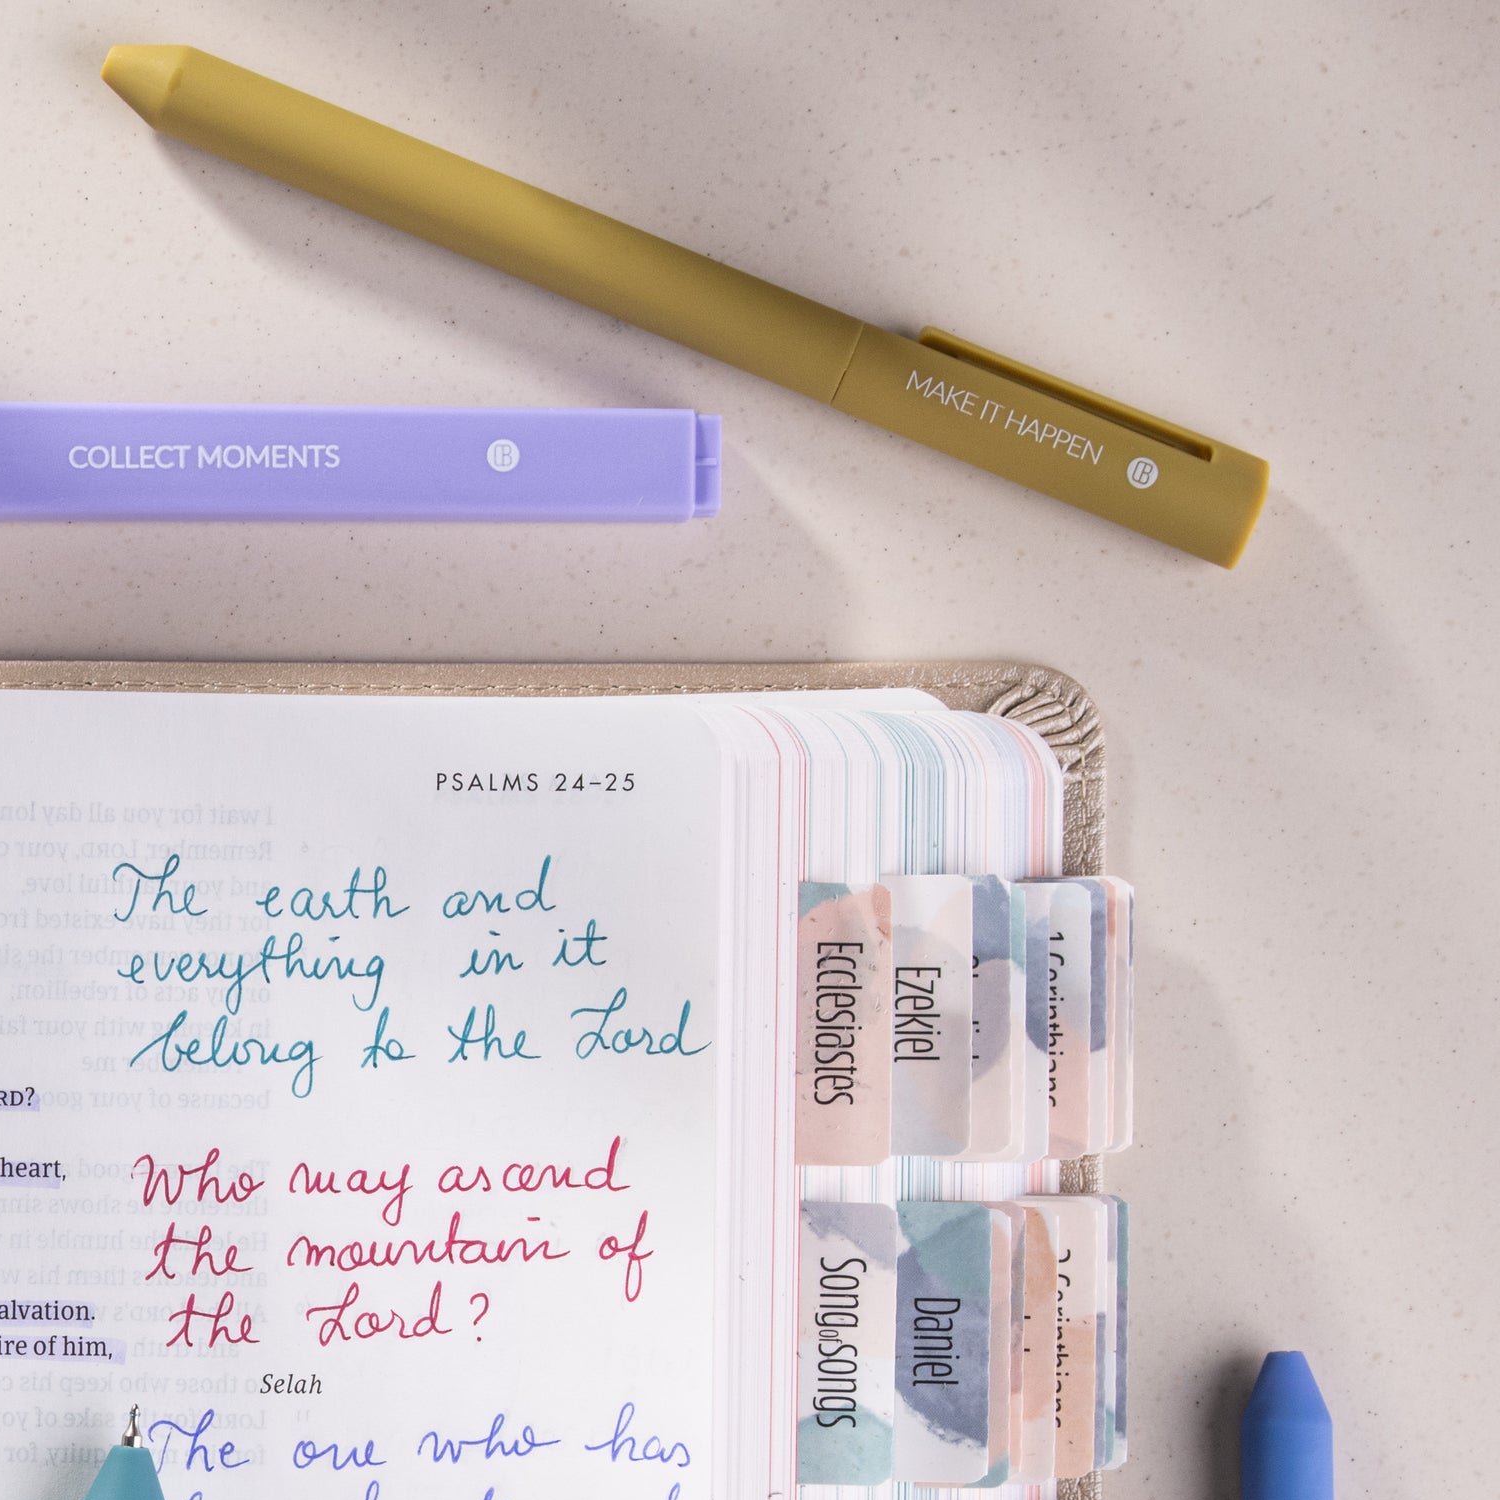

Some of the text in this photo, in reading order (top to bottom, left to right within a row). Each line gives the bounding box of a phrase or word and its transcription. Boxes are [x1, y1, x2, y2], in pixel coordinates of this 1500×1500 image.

[69, 444, 340, 469] COLLECT MOMENTS
[905, 369, 1104, 465] MAKE IT HAPPEN
[436, 772, 539, 792] PSALMS
[113, 853, 556, 922] The earth and
[116, 919, 608, 1014] everything in it
[129, 987, 713, 1098] belong to the Lord
[814, 941, 863, 1106] Ecclesiastes
[894, 966, 941, 1062] Ezekiel
[131, 1135, 631, 1226] Who may ascend
[144, 1209, 654, 1302] the mountain of
[814, 1256, 867, 1330] Song
[166, 1292, 261, 1348] the
[818, 1329, 840, 1346] of
[913, 1296, 961, 1387] Daniel
[259, 1373, 323, 1395] Selah
[147, 1401, 692, 1475] The one who has
